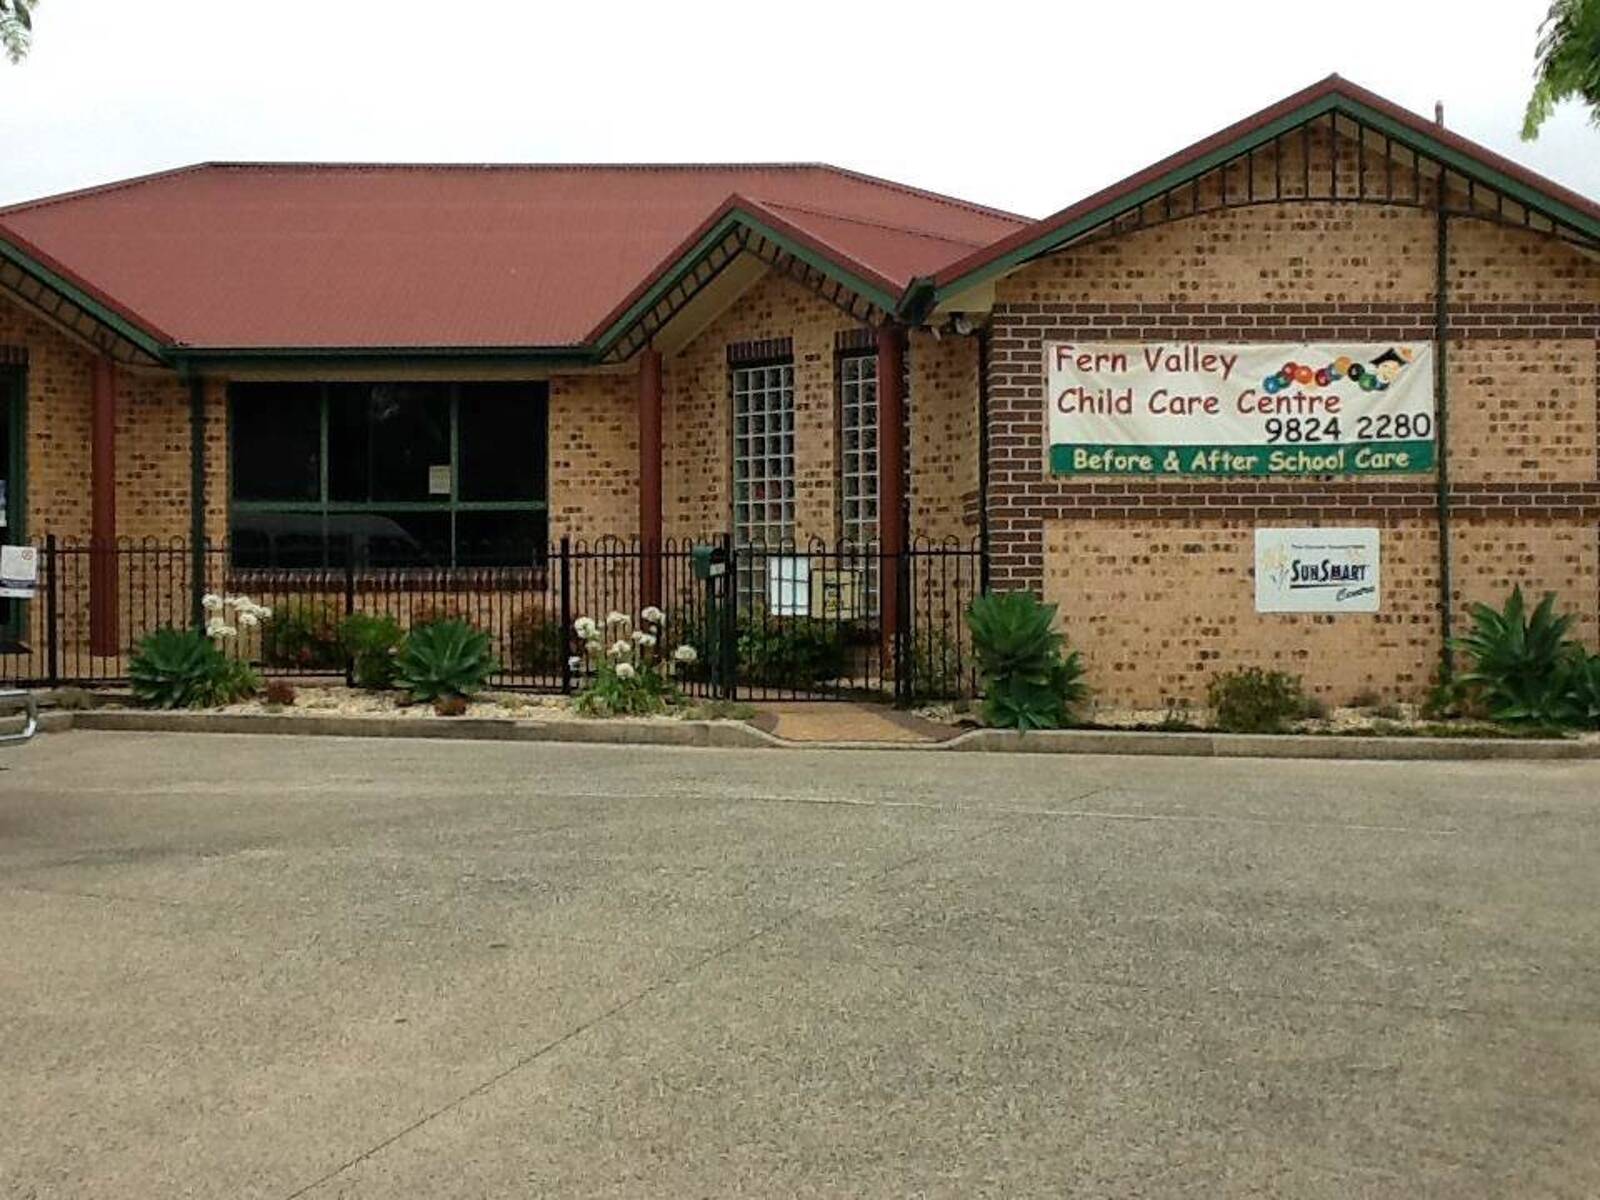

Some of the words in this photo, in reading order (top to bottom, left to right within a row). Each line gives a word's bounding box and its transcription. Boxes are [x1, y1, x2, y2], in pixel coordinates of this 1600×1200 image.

[1055, 345, 1127, 373] Fern
[1144, 346, 1238, 381] Valley
[1057, 387, 1133, 415] Child
[1148, 390, 1220, 415] Care
[1237, 389, 1341, 414] Centre
[1265, 417, 1341, 443] 9824
[1357, 412, 1431, 440] 2280
[1073, 448, 1152, 471] Before
[1163, 450, 1180, 471] &
[1190, 449, 1259, 472] After
[1268, 447, 1345, 472] School
[1355, 445, 1410, 468] Care
